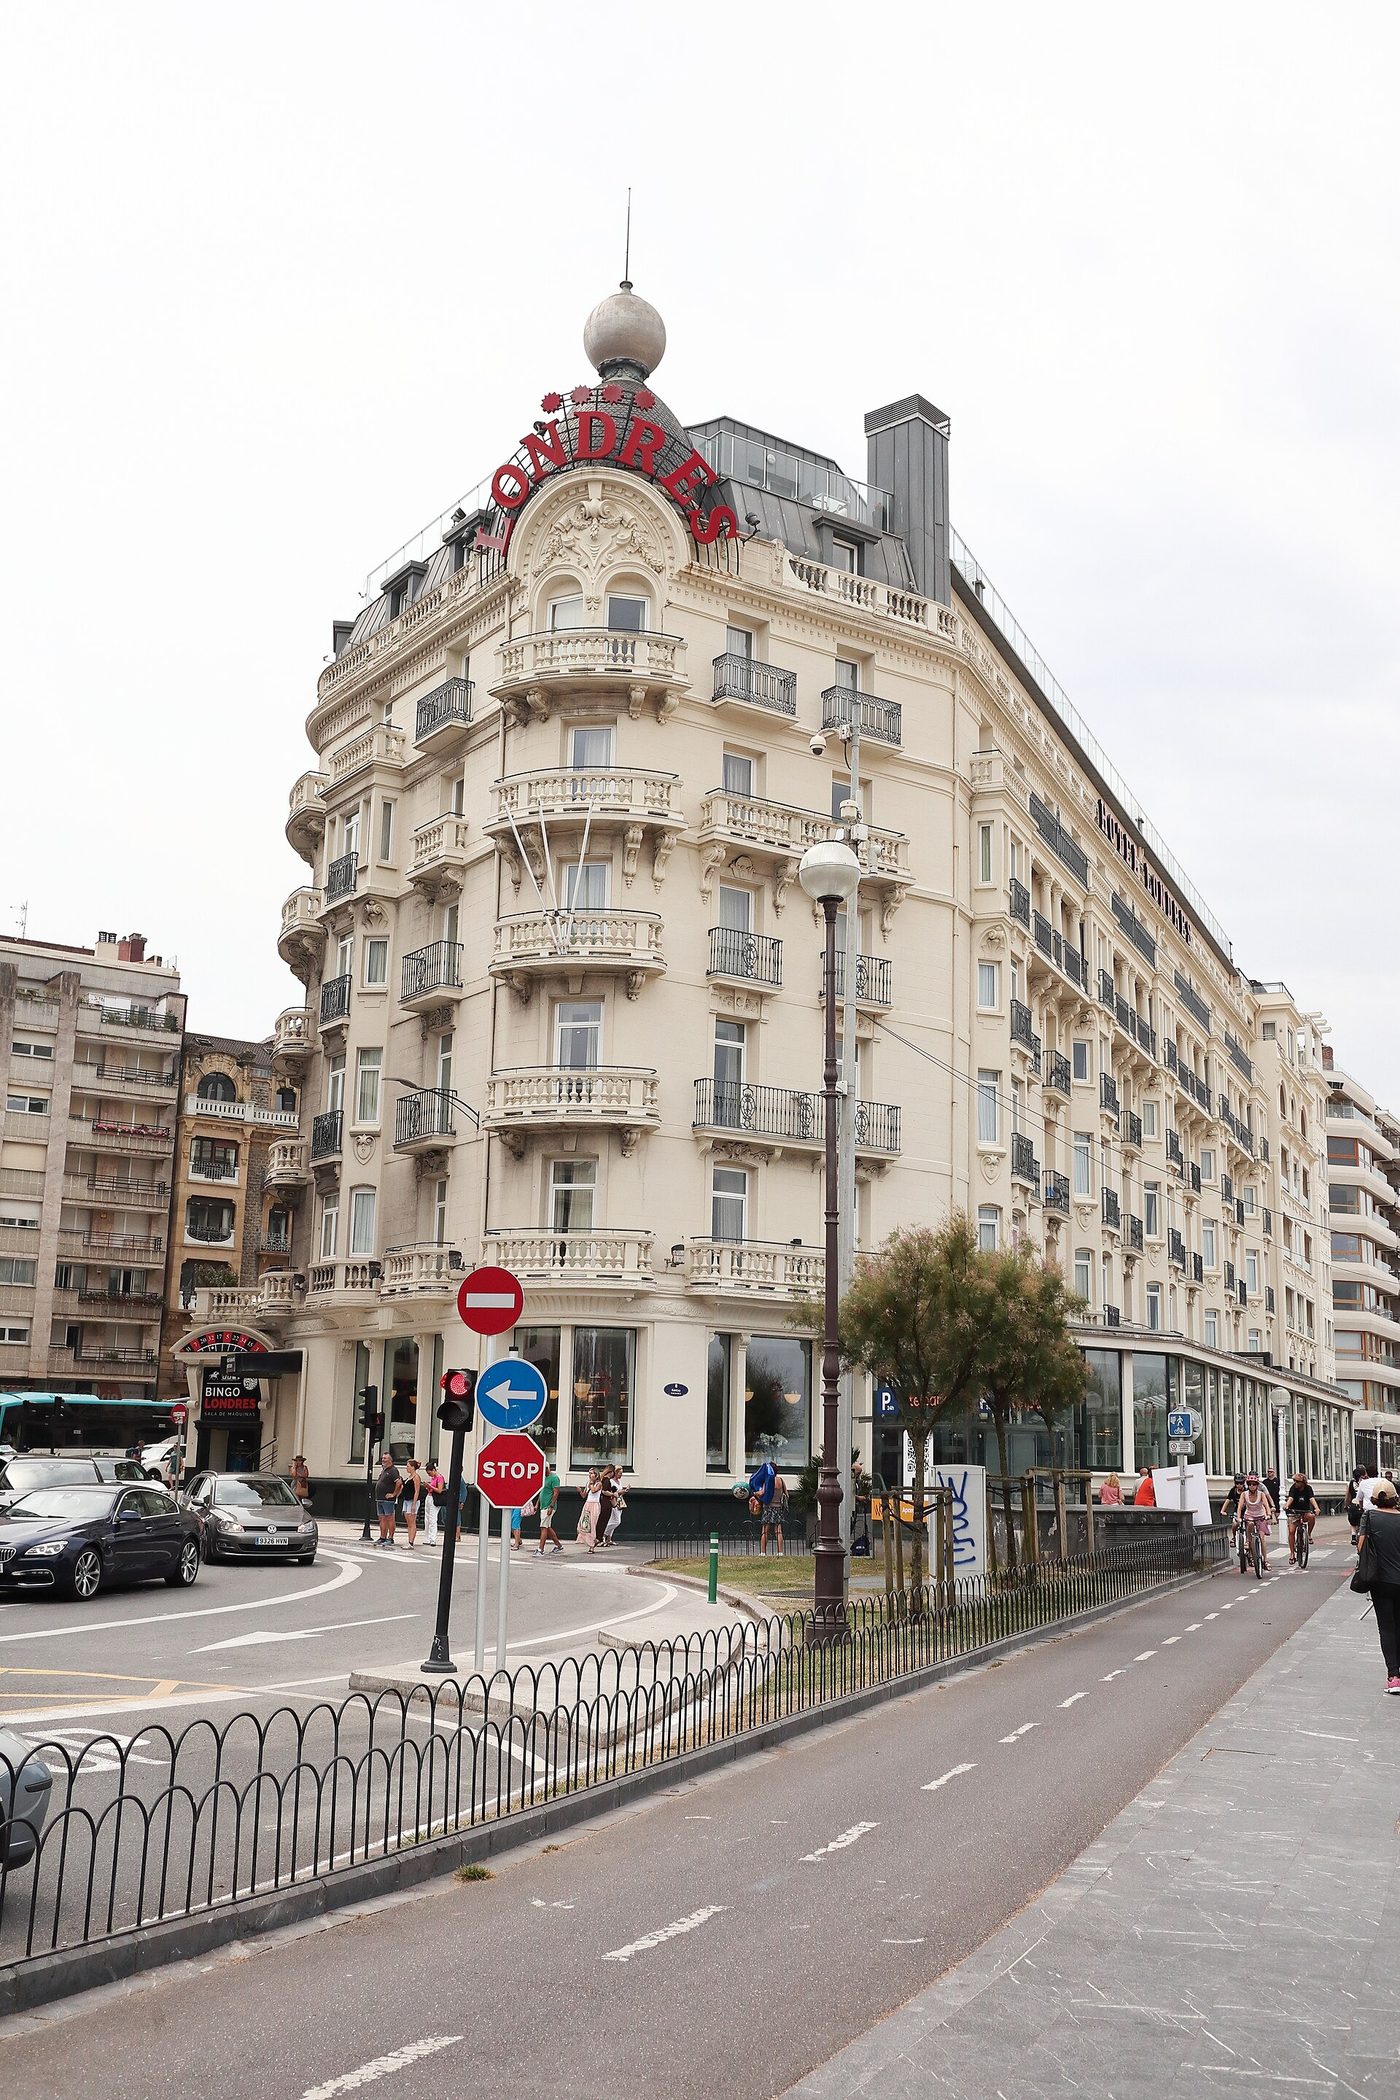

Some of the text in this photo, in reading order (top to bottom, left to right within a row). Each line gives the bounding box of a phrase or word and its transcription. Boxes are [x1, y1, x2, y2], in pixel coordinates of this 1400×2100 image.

[475, 410, 741, 557] LONDRES
[1097, 798, 1192, 947] HOTEL LONDRES
[205, 1386, 241, 1397] BINGO
[204, 1398, 256, 1409] LONDRES
[882, 1392, 891, 1411] P
[482, 1460, 540, 1480] STOP
